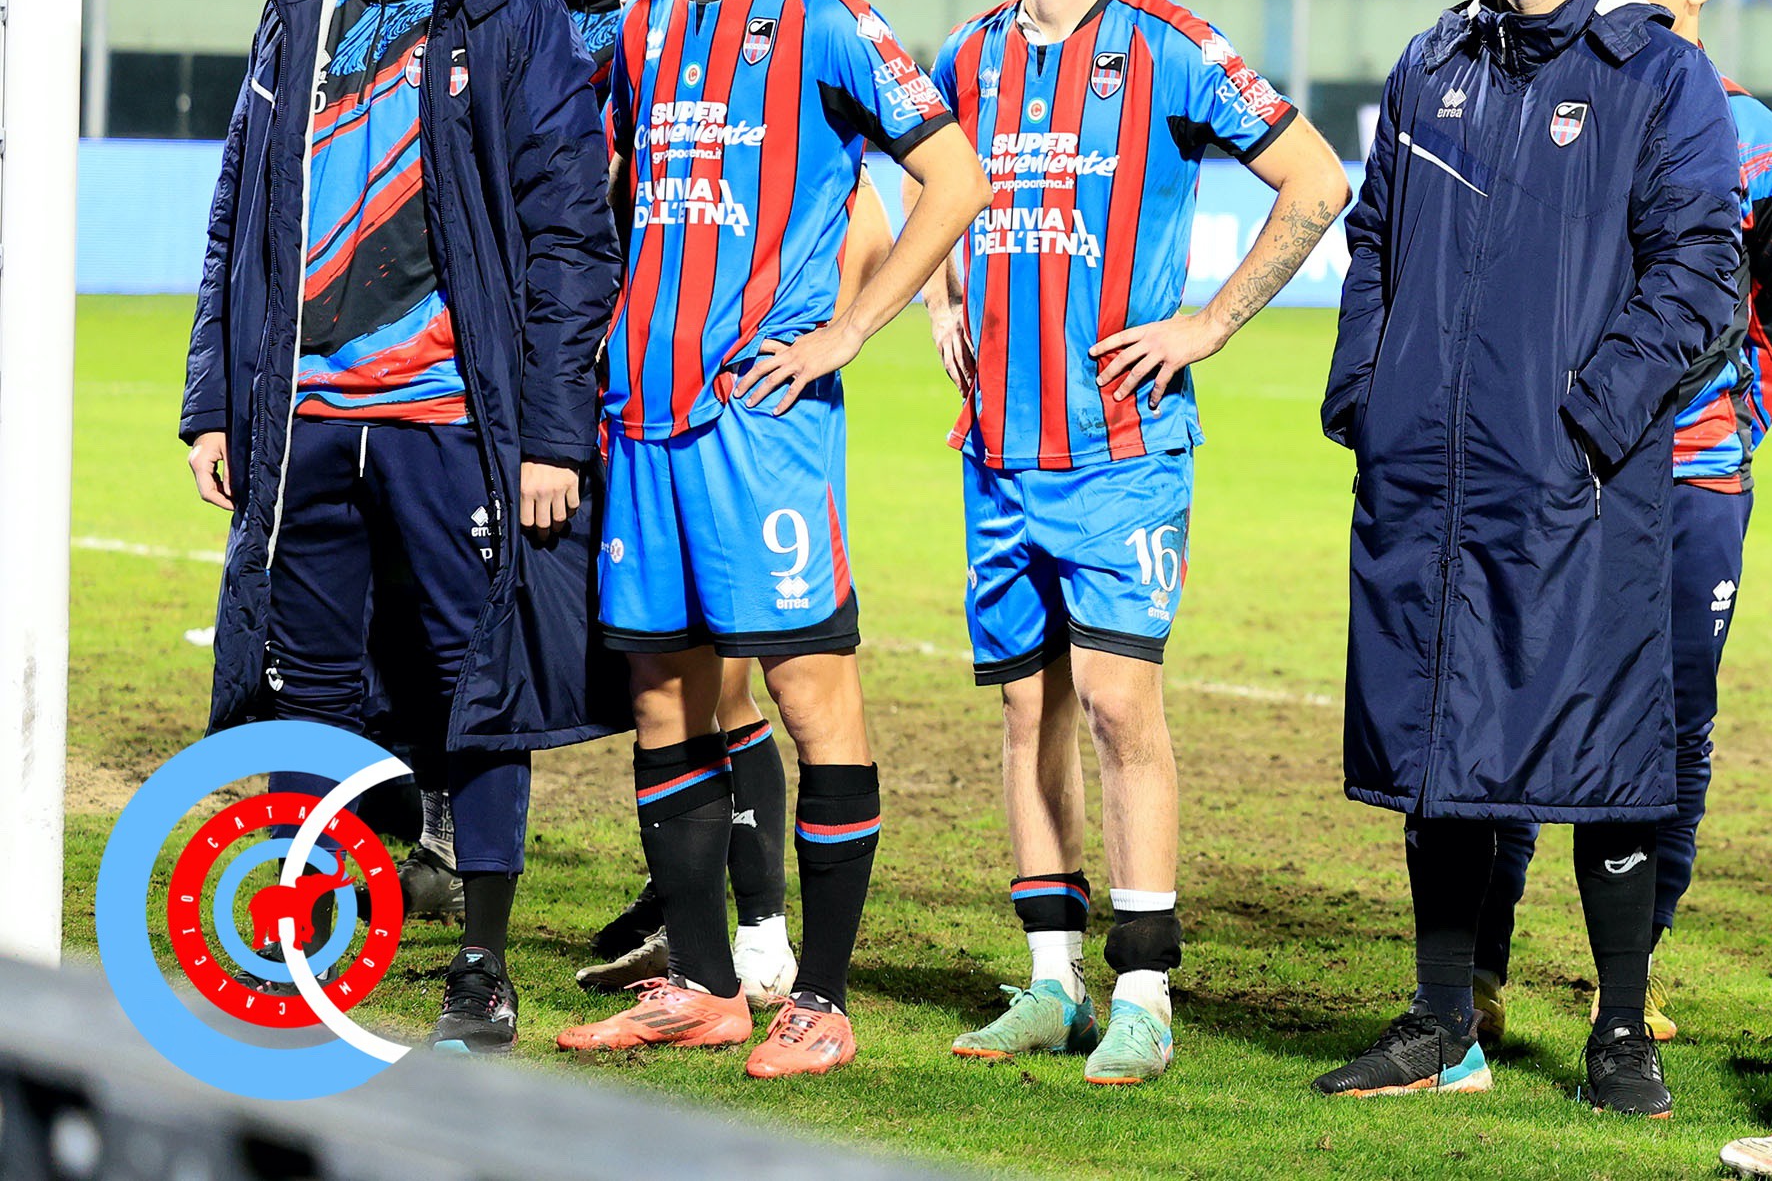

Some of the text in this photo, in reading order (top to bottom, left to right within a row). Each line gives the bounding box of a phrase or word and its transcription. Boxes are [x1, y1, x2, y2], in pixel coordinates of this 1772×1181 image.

[651, 101, 728, 125] SUPER
[1437, 108, 1463, 118] errea
[991, 132, 1079, 155] SUPER
[978, 150, 1120, 177] onveniente
[992, 177, 1075, 194] gruppoarena.it
[974, 207, 1066, 233] FUNIVIA
[974, 230, 1101, 266] DELL'ETNA
[762, 508, 810, 577] 9
[1124, 525, 1179, 592] 16
[776, 597, 810, 609] errea
